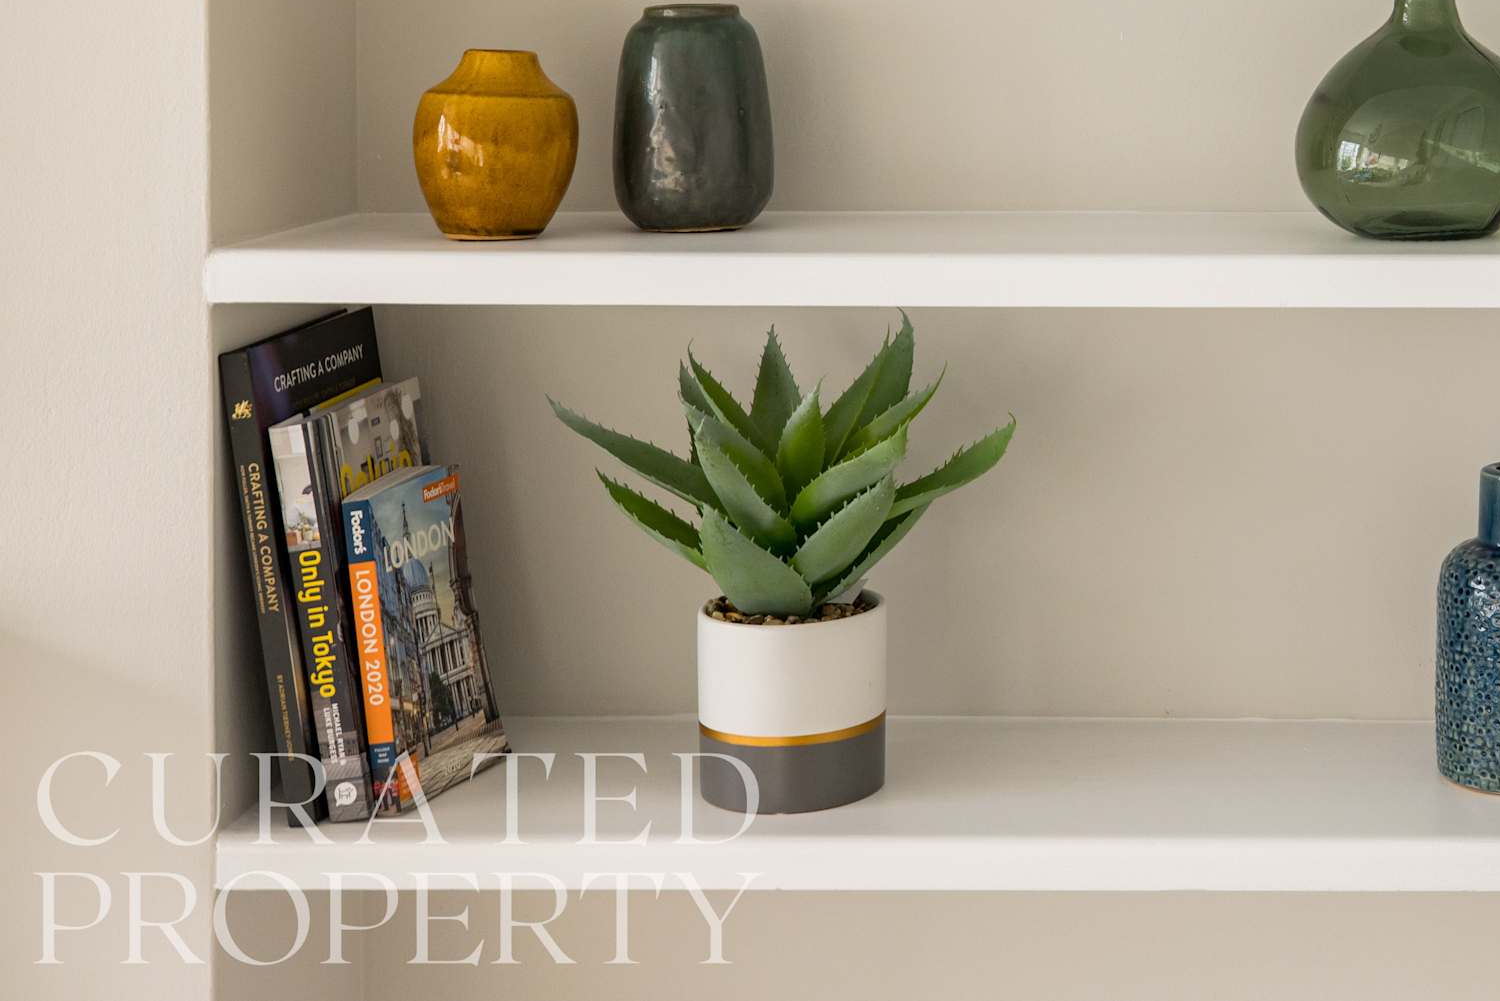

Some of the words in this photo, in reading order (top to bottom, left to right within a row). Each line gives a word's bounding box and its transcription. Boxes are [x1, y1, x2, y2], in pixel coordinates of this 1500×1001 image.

[273, 362, 317, 393] CRAFTING
[317, 360, 325, 376] A
[324, 343, 364, 372] COMPANY
[248, 462, 268, 530] CRAFTING
[257, 533, 269, 544] A
[350, 509, 368, 556] Fodor's
[383, 516, 456, 573] LONDON
[260, 545, 280, 612] COMPANY
[298, 550, 325, 603] Only
[307, 605, 329, 629] in
[355, 569, 379, 654] LONDON
[310, 630, 337, 698] Tokyo
[365, 660, 385, 707] 2020
[323, 706, 333, 728] LUKE
[331, 702, 343, 737] MICHAEL
[337, 738, 346, 758] RYAN
[326, 728, 339, 765] BURGESS
